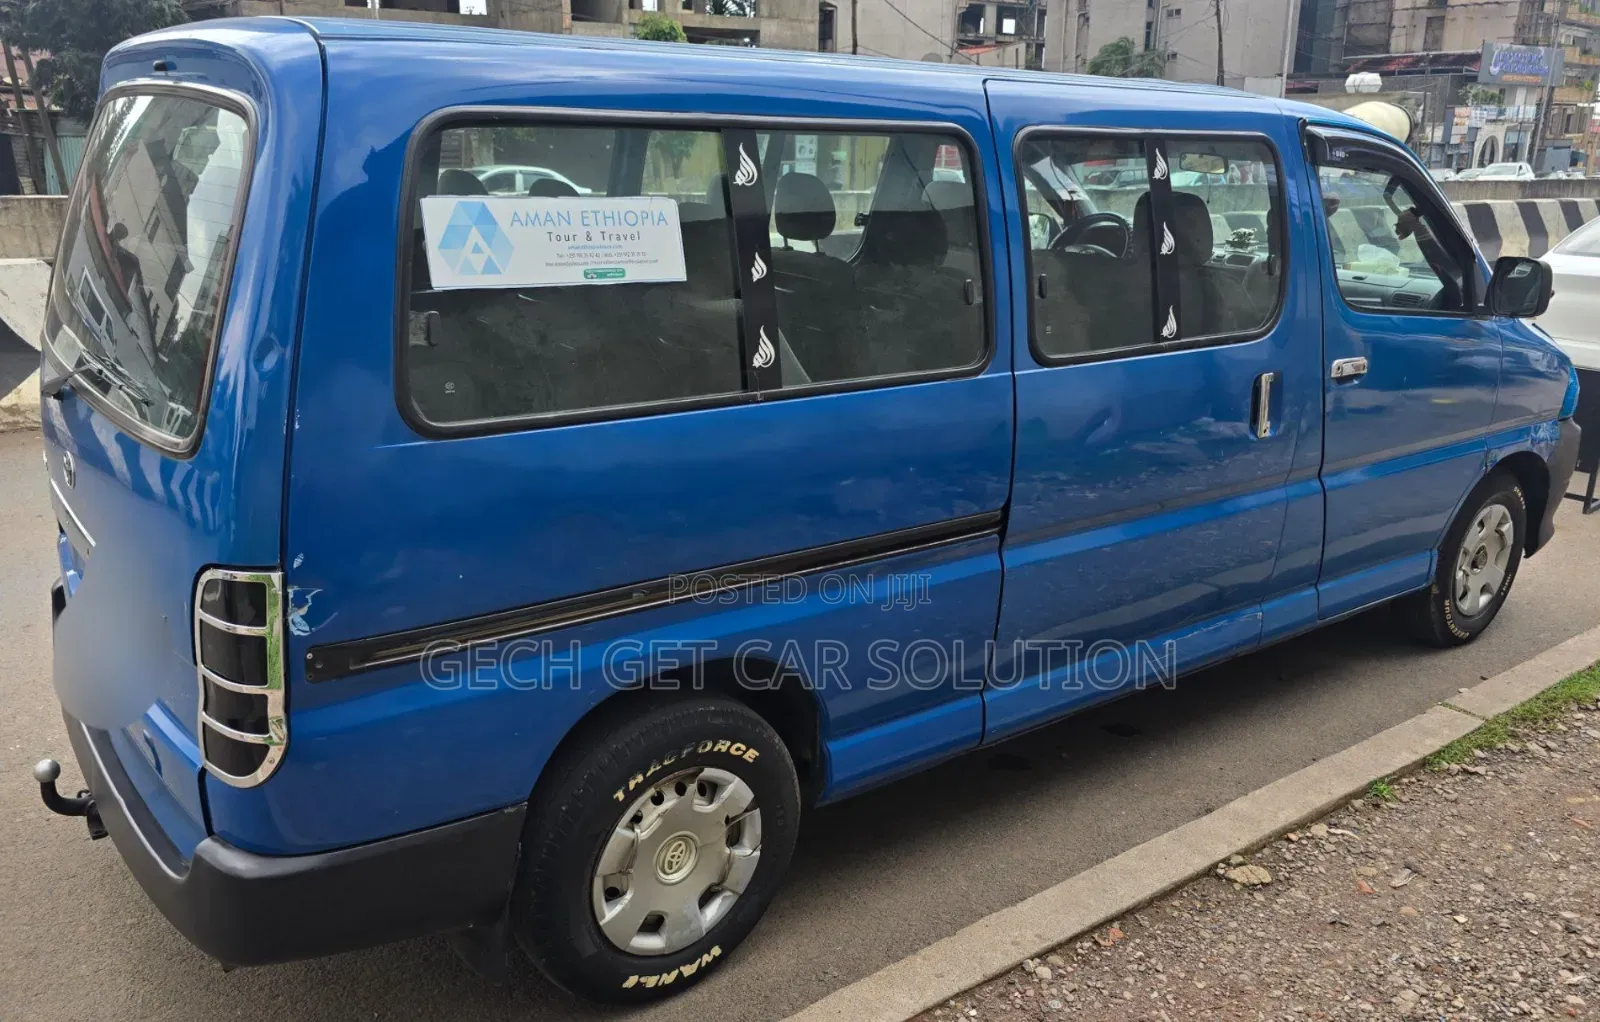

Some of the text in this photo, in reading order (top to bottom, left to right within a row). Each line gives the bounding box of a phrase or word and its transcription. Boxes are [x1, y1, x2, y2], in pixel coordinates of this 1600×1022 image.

[510, 209, 669, 228] AMAN ETHIOPIA
[547, 230, 642, 243] Tour & Travel
